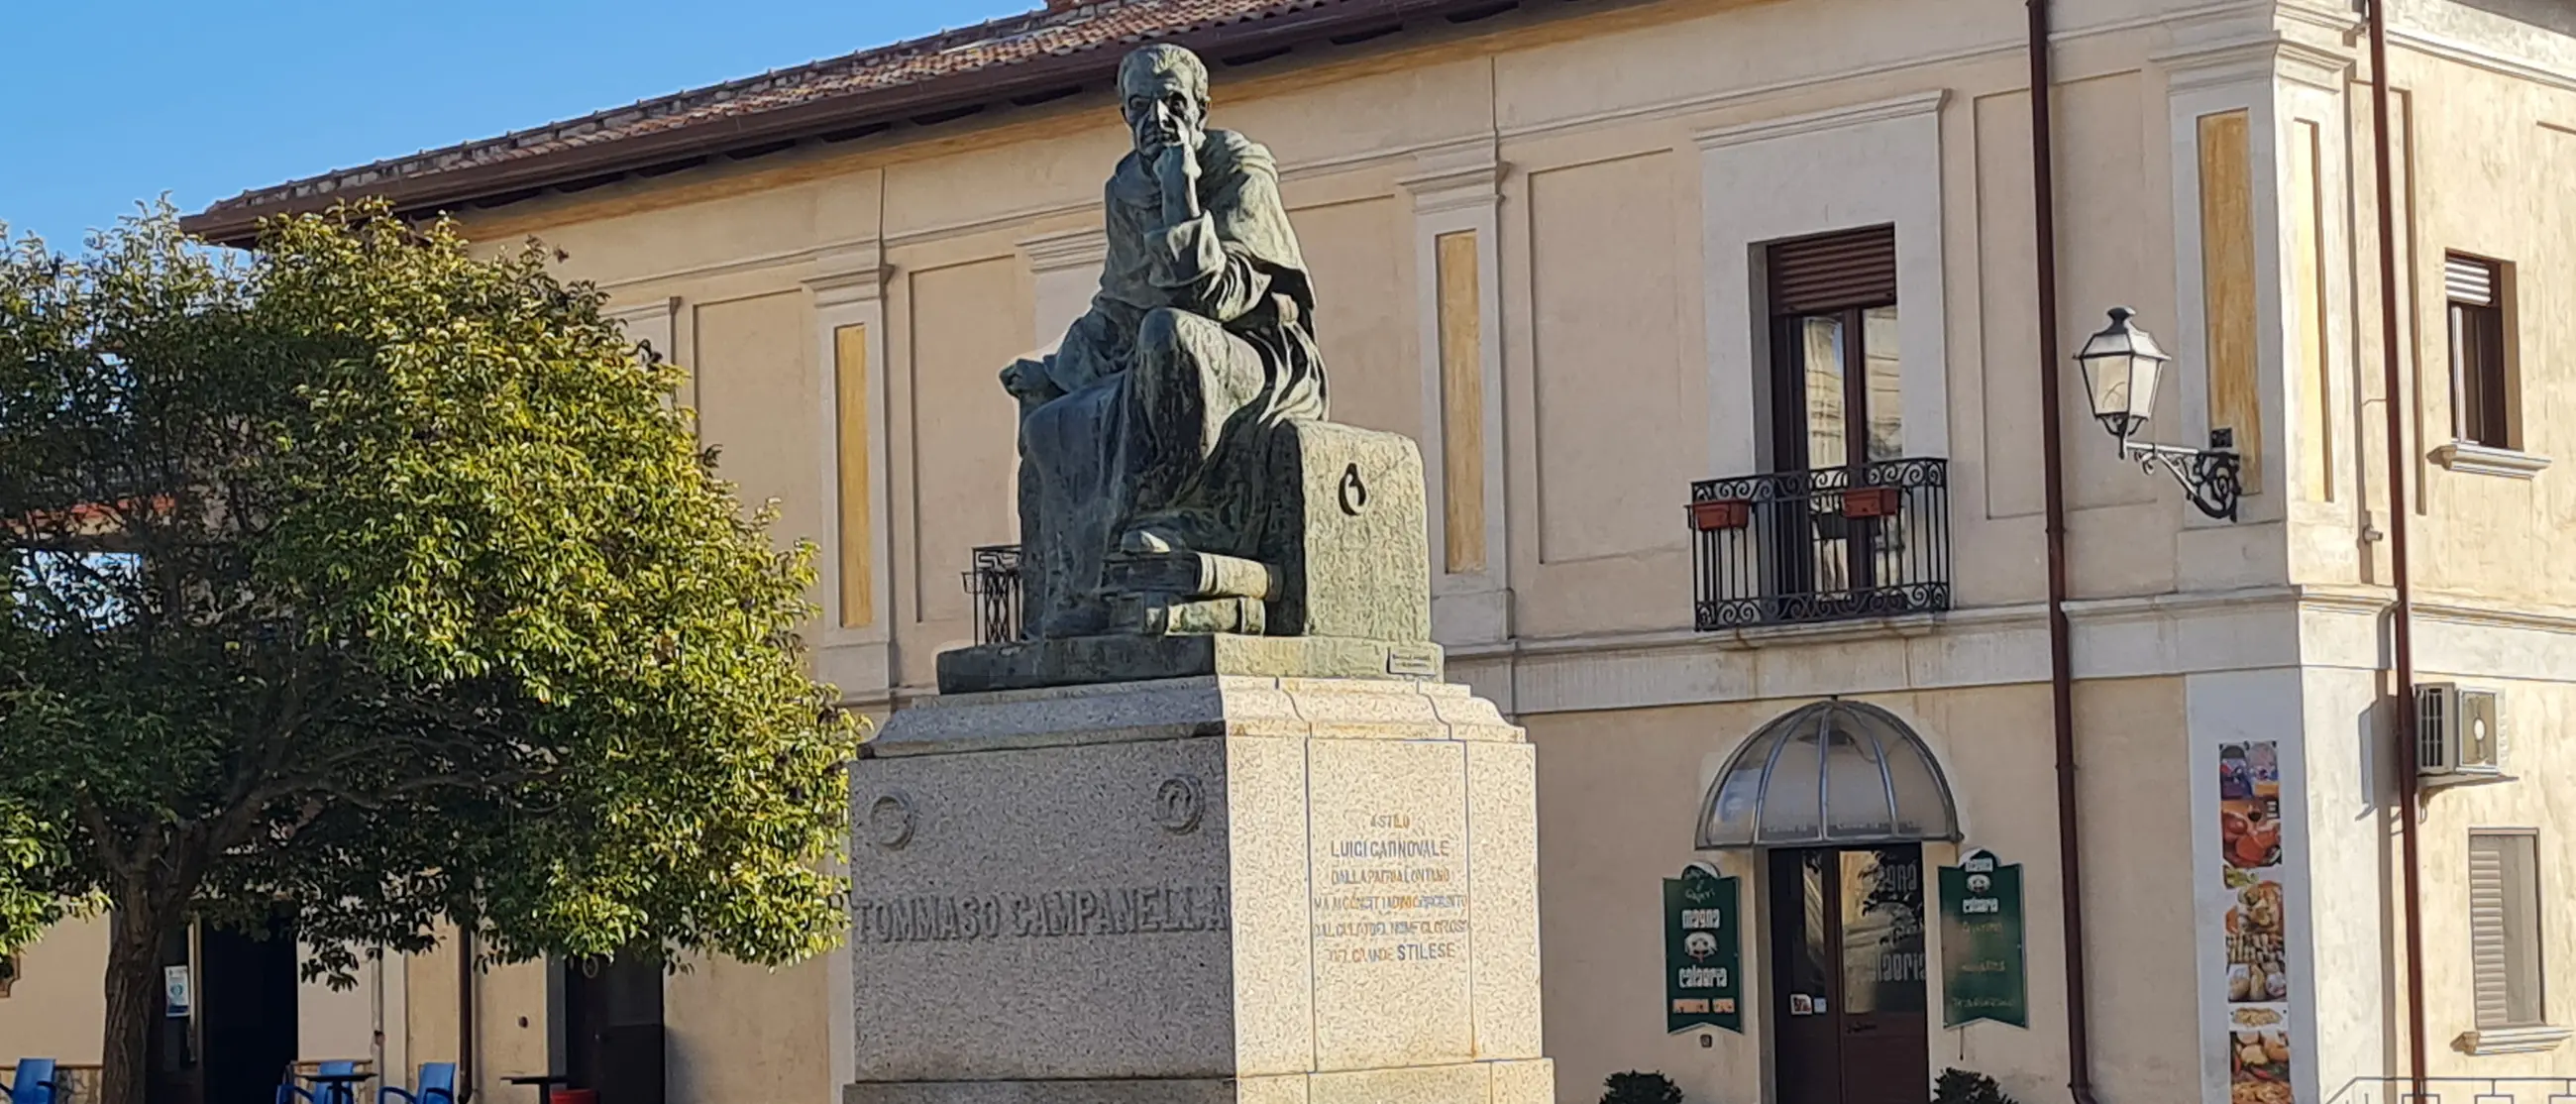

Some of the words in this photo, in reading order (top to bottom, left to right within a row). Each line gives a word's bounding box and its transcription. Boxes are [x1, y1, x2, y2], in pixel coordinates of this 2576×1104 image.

[1331, 839, 1367, 858] LUIGI
[1370, 839, 1450, 859] CARNOVALE
[852, 894, 1002, 942] TOMMASO
[1012, 887, 1228, 938] CAMPANELLA
[1397, 942, 1455, 961] STILESE
